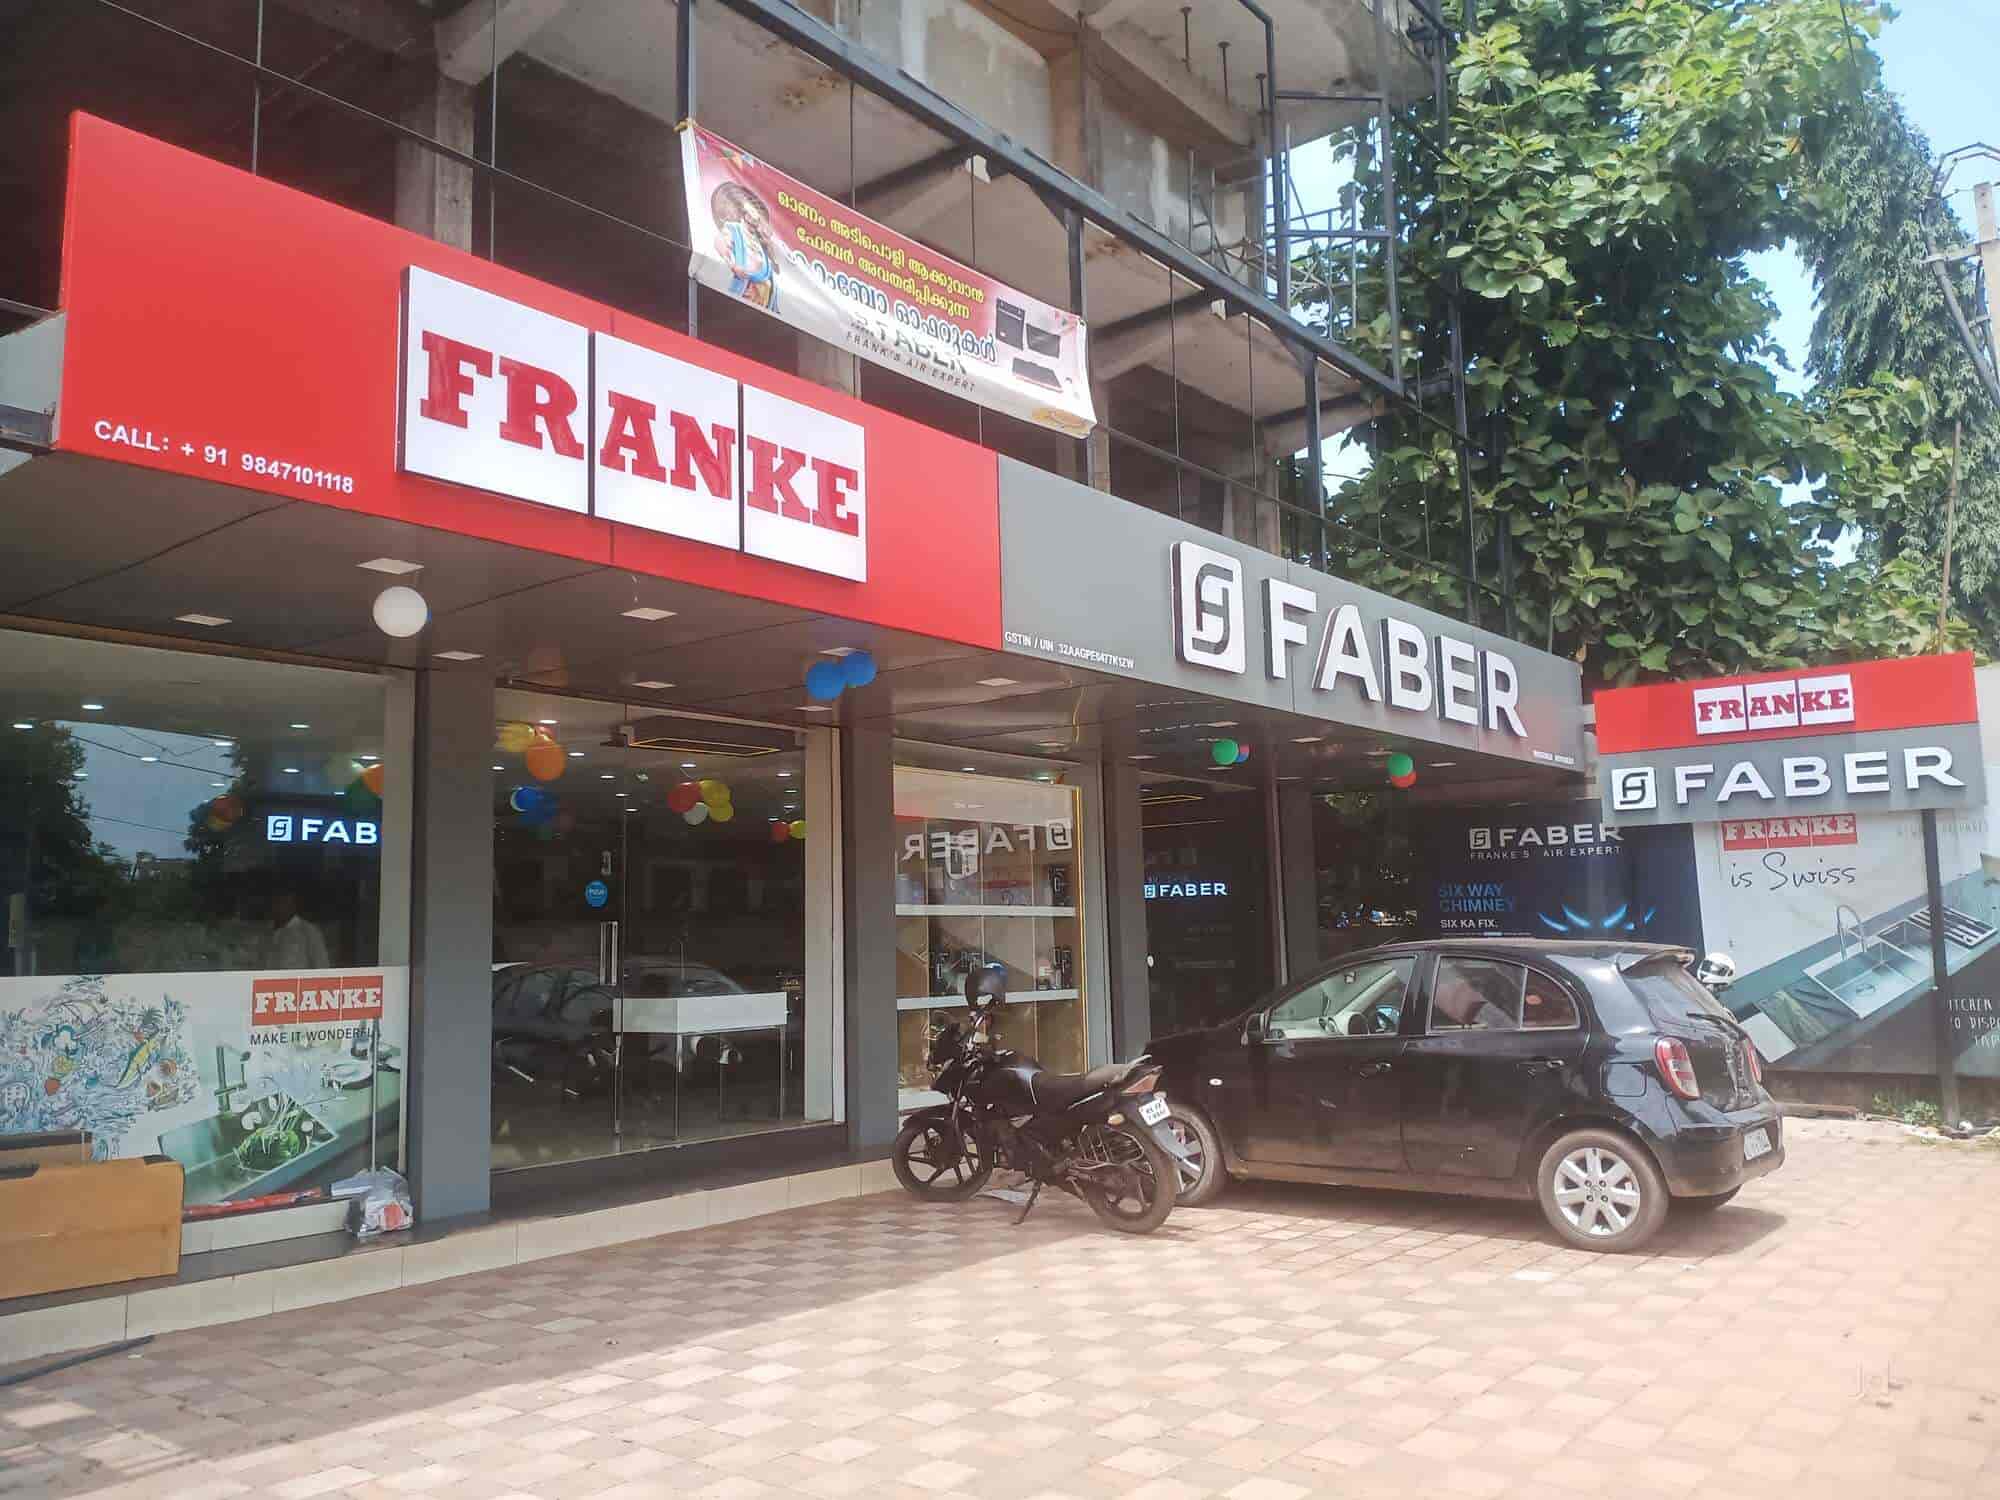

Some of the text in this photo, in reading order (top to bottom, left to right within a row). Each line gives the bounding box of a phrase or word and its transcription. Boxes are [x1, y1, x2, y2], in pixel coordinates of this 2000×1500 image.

[420, 330, 858, 537] FRANKE
[94, 420, 169, 452] CALL:
[204, 445, 228, 466] 91
[241, 453, 353, 494] 9847101118
[1263, 577, 1527, 738] FABER
[1698, 687, 1850, 722] FRANKE
[1674, 746, 1966, 804] FABER
[1500, 824, 1624, 847] FABER
[1725, 815, 1855, 841] FRANKE
[1543, 849, 1564, 857] AIR
[1570, 846, 1621, 857] EXPERT
[1731, 851, 1857, 891] is Swiss
[1160, 883, 1227, 897] FABER
[1440, 919, 1458, 929] SIX
[1460, 919, 1476, 929] KA
[255, 988, 381, 1013] FRANKE
[250, 1032, 288, 1046] MAKE
[291, 1031, 301, 1043] IT
